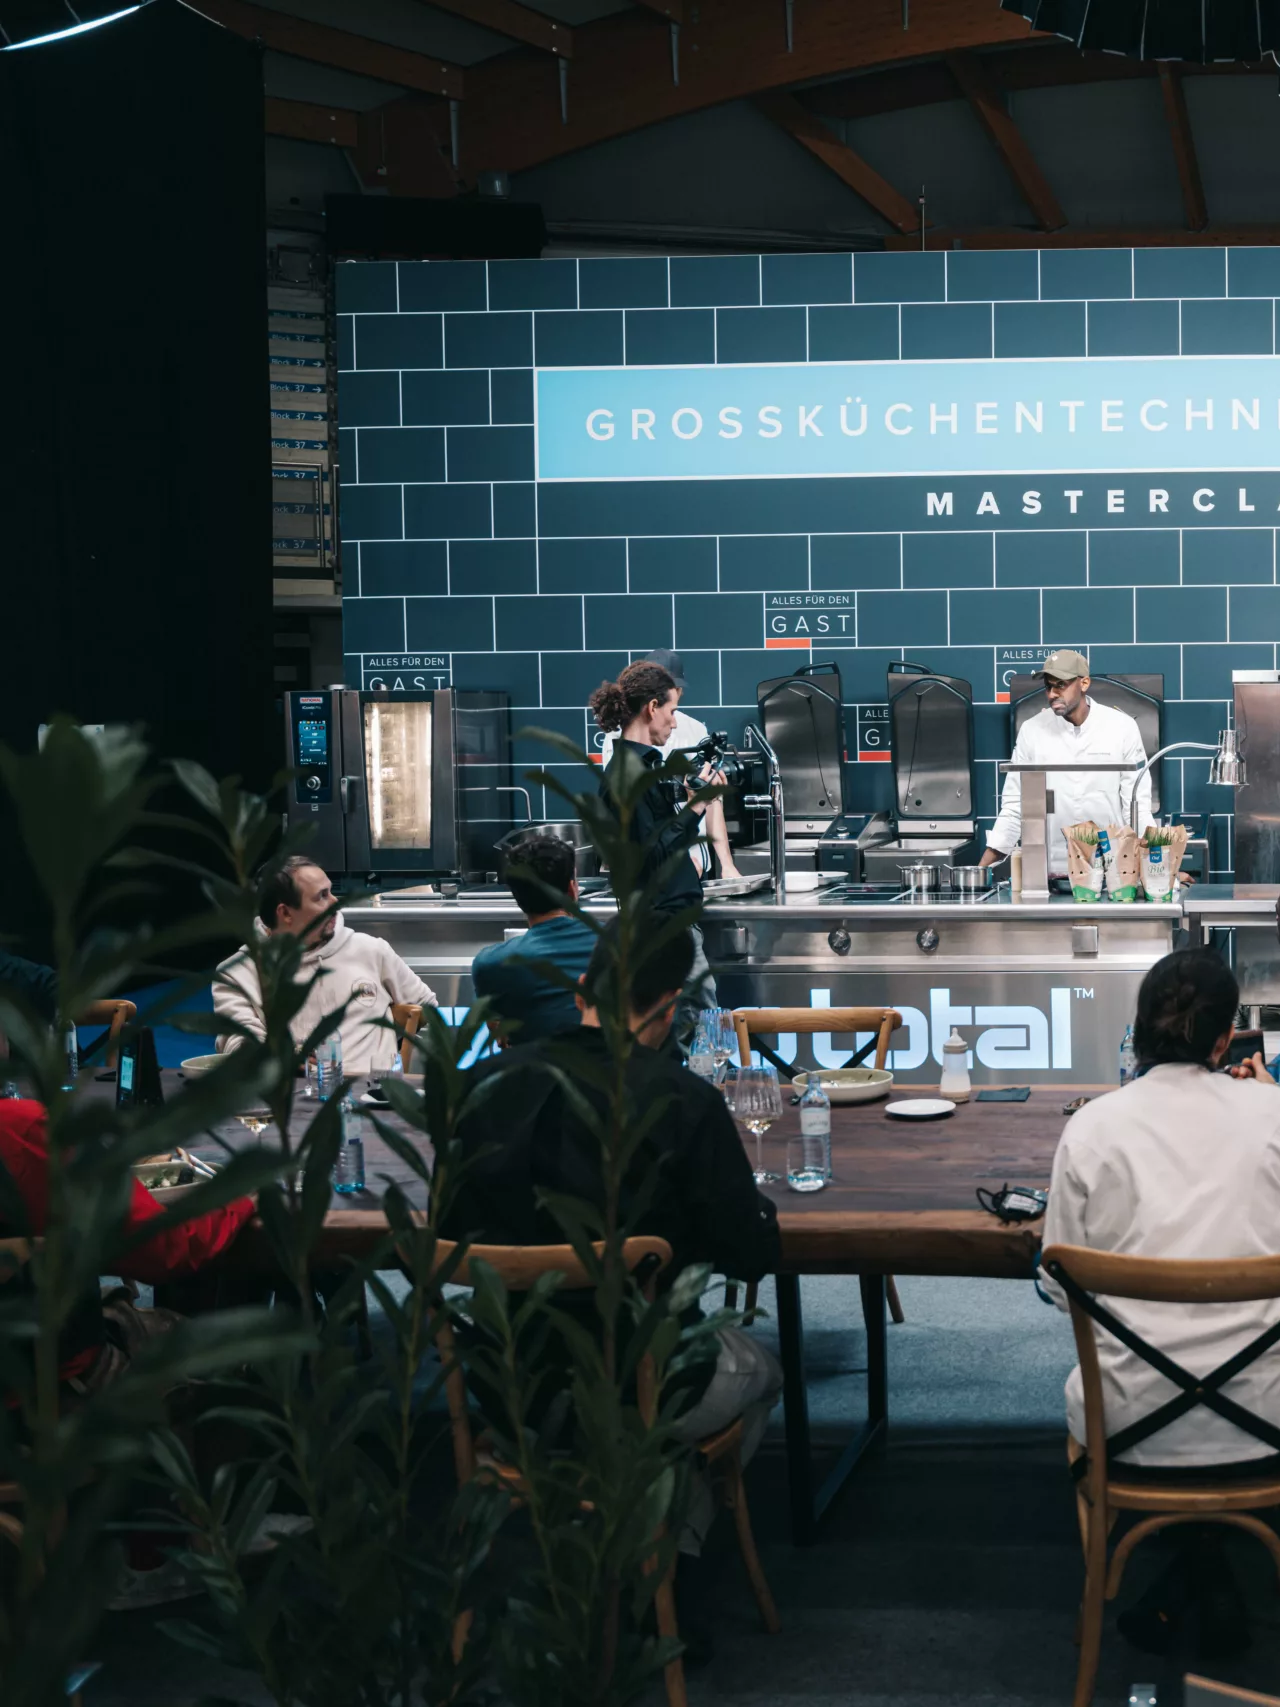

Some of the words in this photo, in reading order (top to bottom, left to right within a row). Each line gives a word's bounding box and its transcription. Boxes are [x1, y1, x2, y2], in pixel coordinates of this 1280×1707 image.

[296, 335, 306, 343] 37
[270, 384, 290, 392] Block
[295, 384, 306, 393] 37
[270, 412, 290, 420] Block
[294, 441, 306, 450] 37
[294, 472, 306, 480] 37
[295, 505, 306, 514] 37
[272, 541, 287, 549] ock
[294, 540, 306, 549] 37
[772, 597, 802, 605] ALLES
[806, 594, 825, 605] FÜR
[828, 596, 850, 604] DEN
[771, 615, 851, 634] GAST
[1003, 651, 1034, 659] ALLES
[370, 658, 399, 667] ALLES
[402, 656, 421, 667] FÜR
[425, 657, 445, 666] DEN
[370, 676, 446, 690] GAST
[865, 709, 888, 718] ALLE
